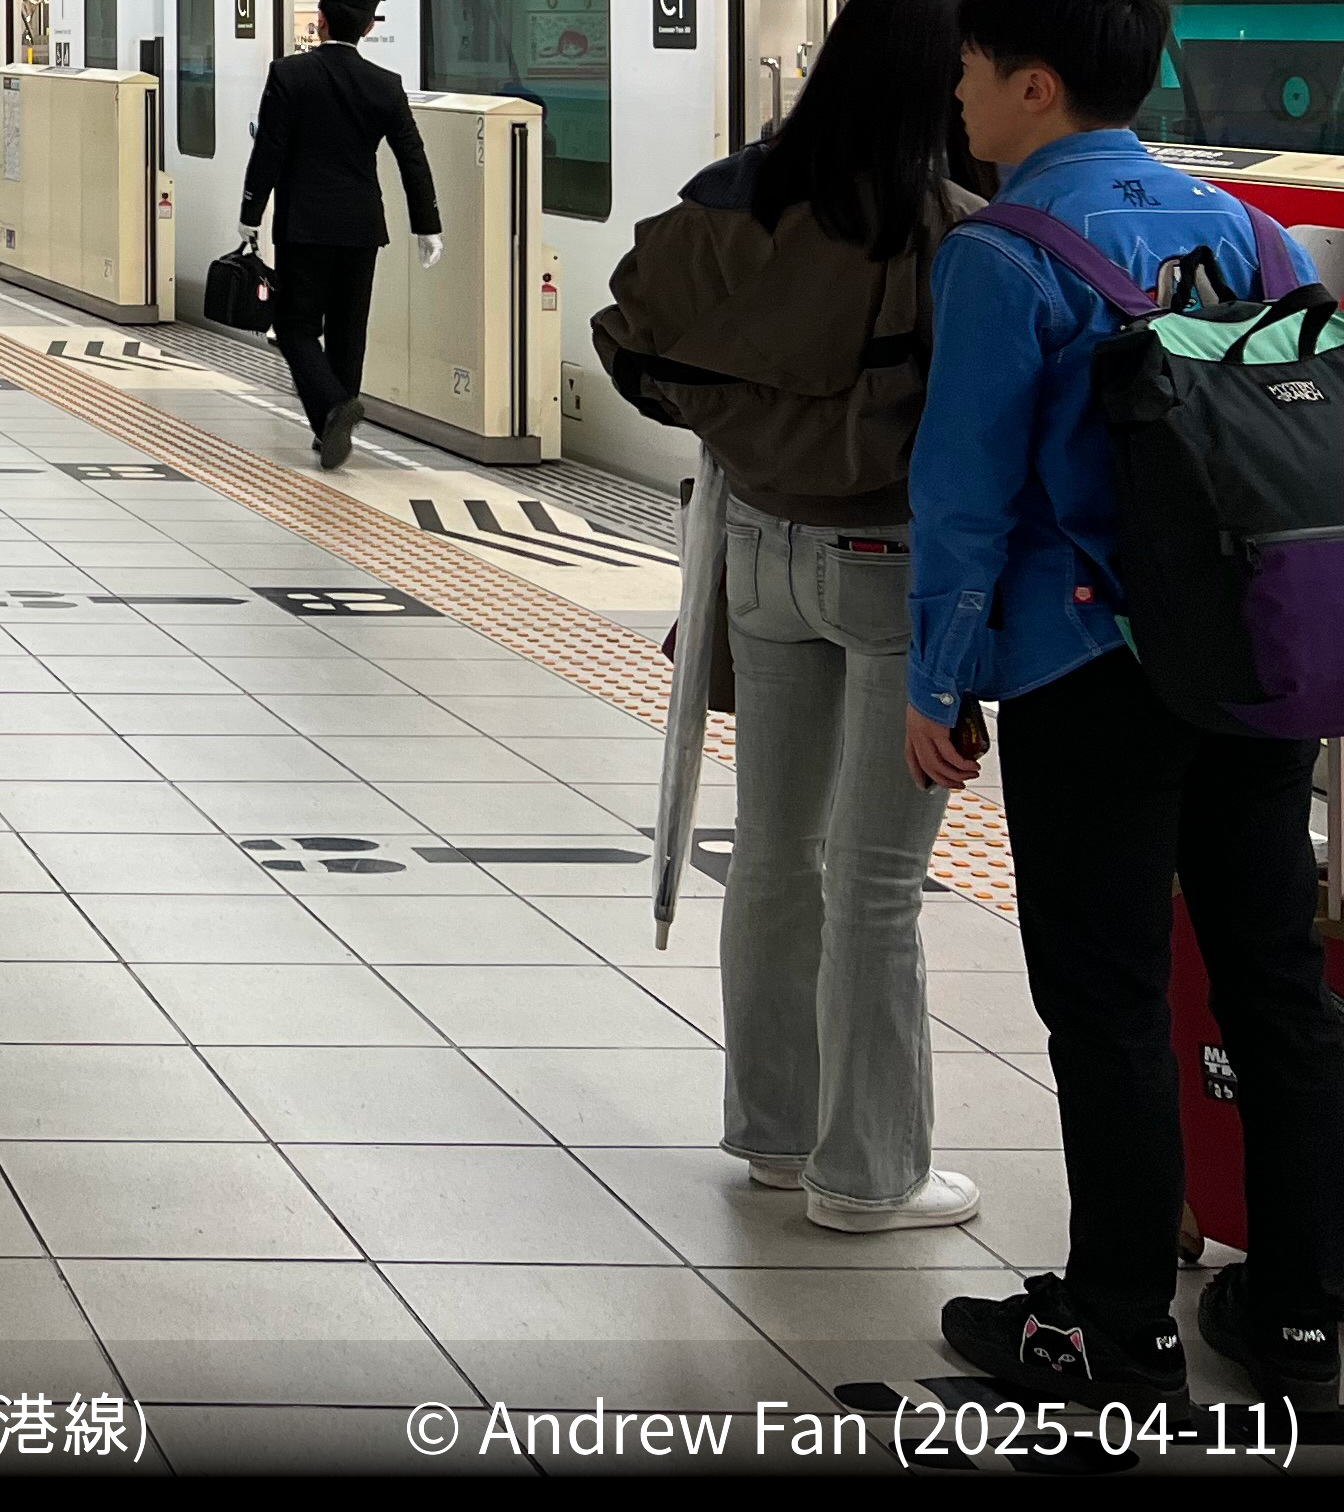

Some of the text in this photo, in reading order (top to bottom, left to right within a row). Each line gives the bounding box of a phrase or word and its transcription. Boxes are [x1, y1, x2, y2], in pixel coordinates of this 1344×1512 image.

[477, 117, 484, 139] 2
[478, 145, 484, 164] 2
[1113, 179, 1162, 207] 祝
[1282, 1327, 1326, 1342] PUMA
